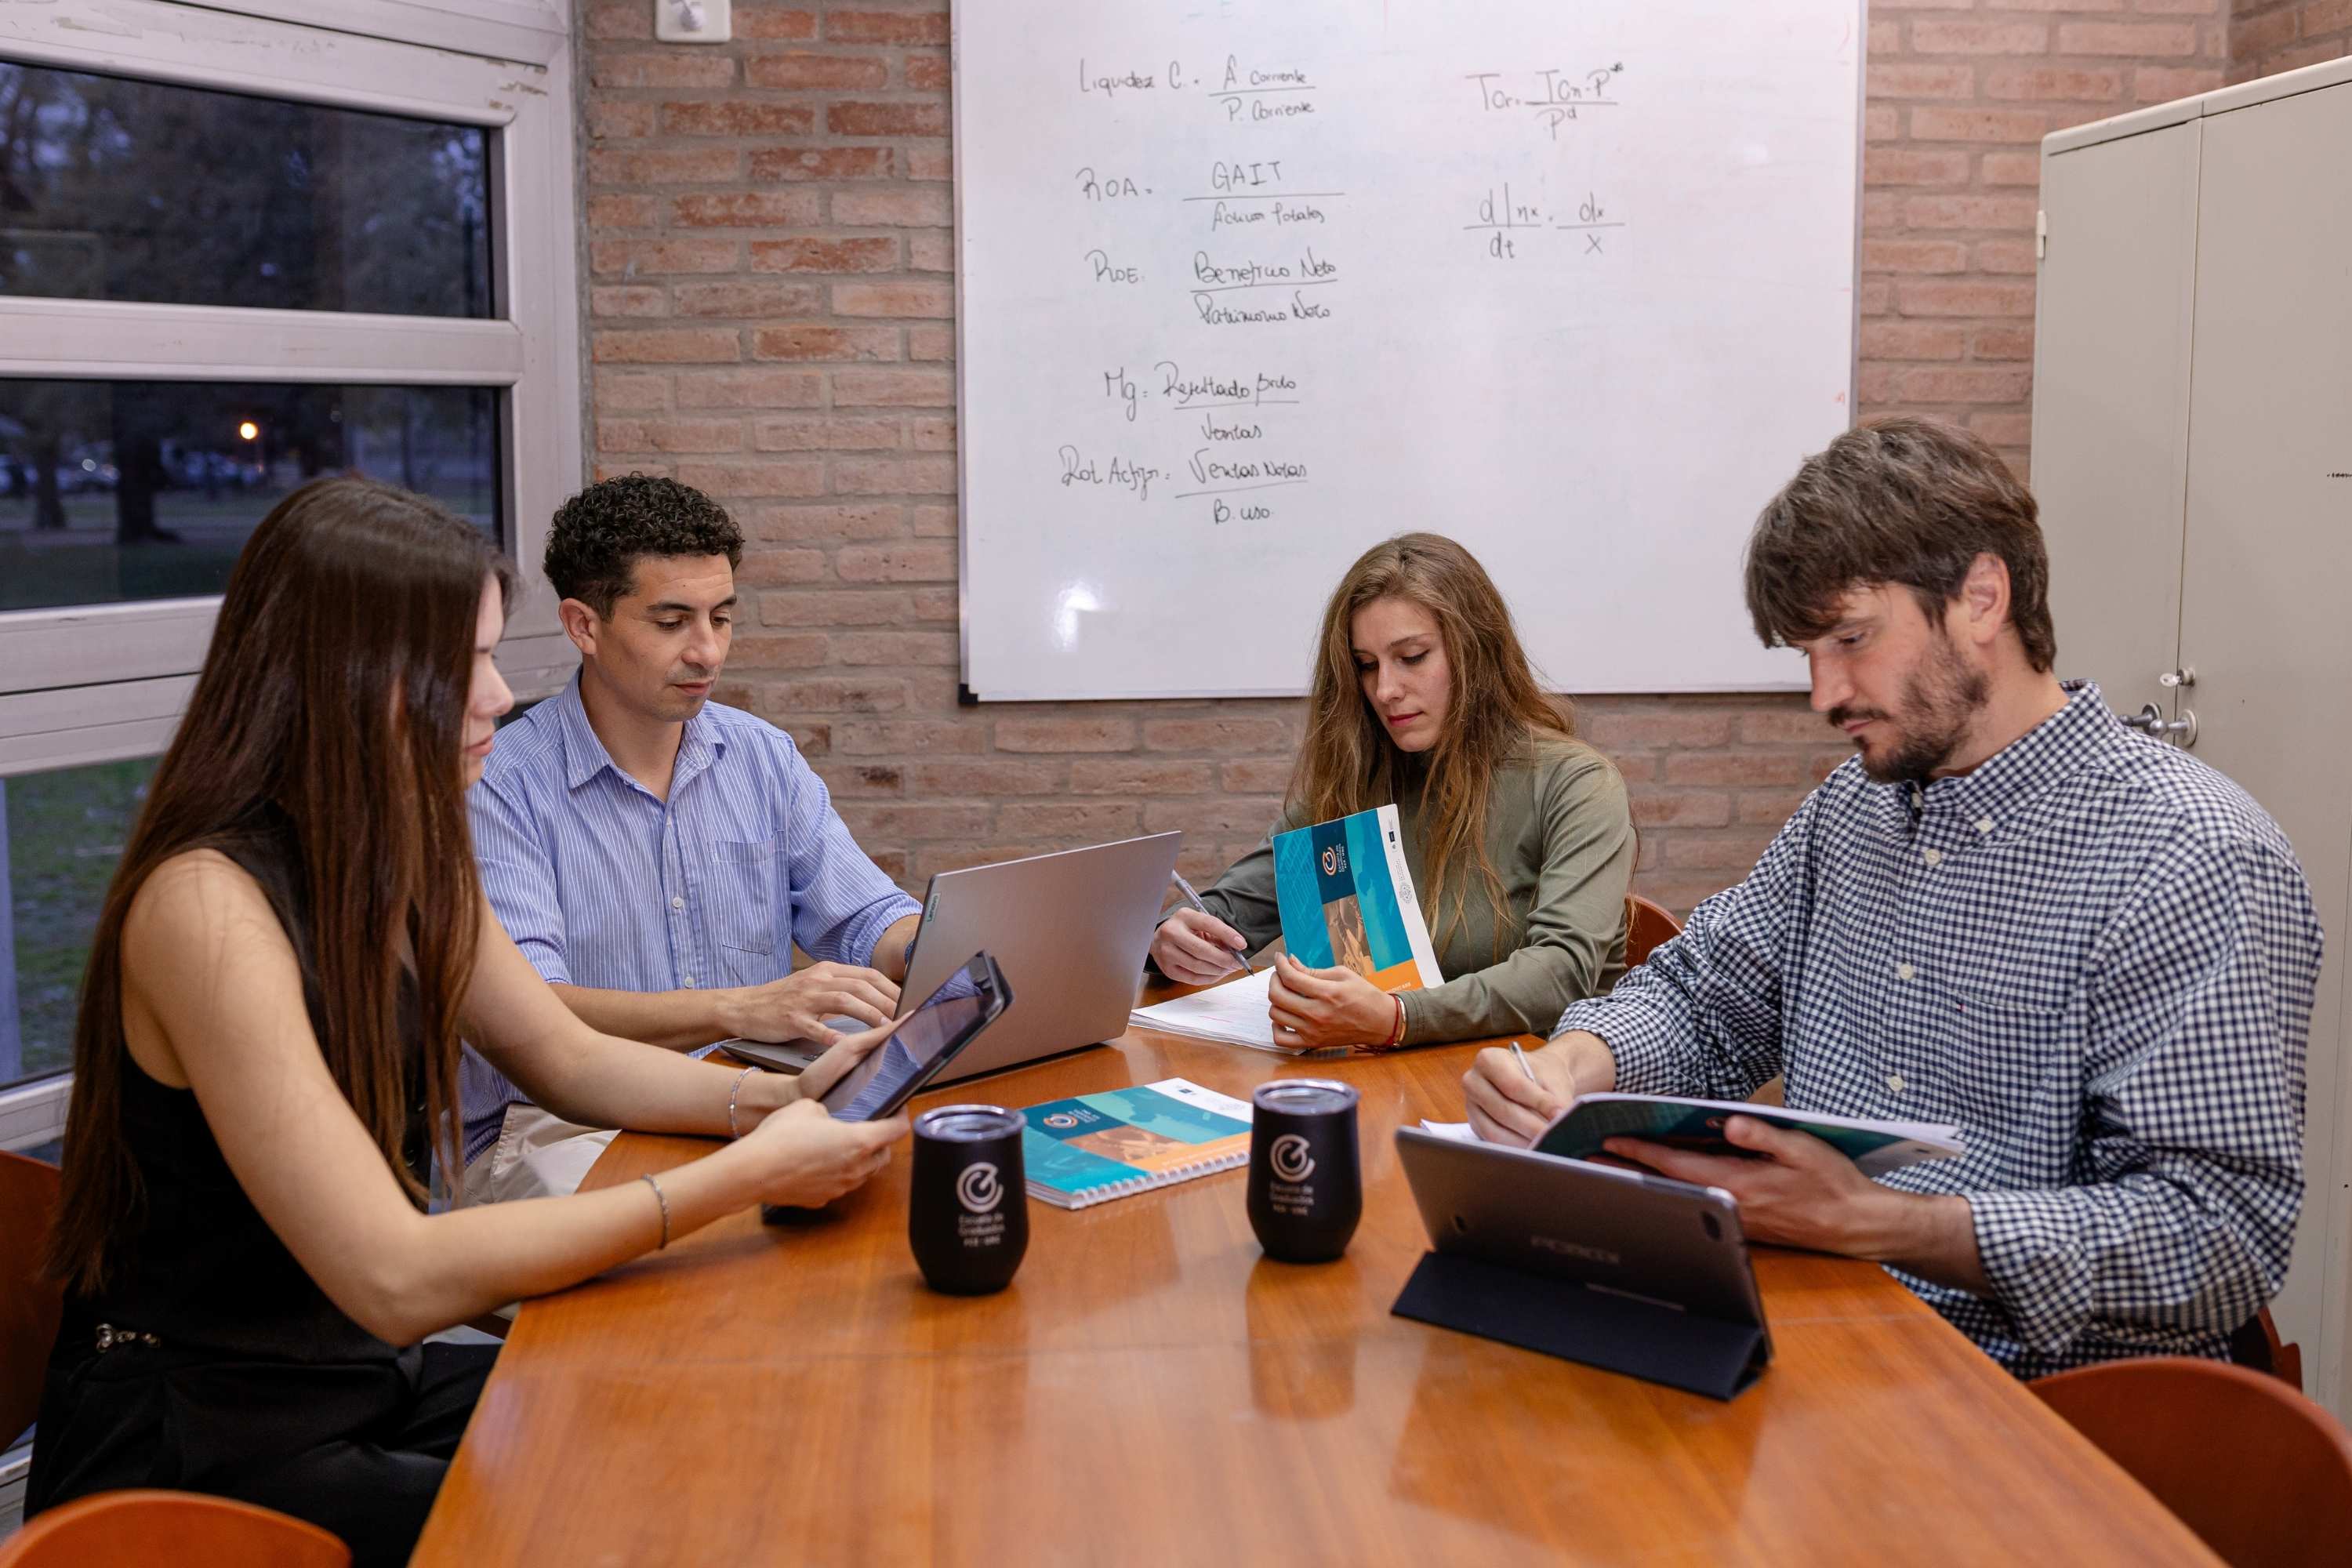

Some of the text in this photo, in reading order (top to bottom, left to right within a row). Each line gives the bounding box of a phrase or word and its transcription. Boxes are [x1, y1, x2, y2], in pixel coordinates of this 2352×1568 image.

[1301, 245, 1338, 279] Neto
[1201, 412, 1262, 441] Ventas
[1189, 448, 1259, 484] Ventas
